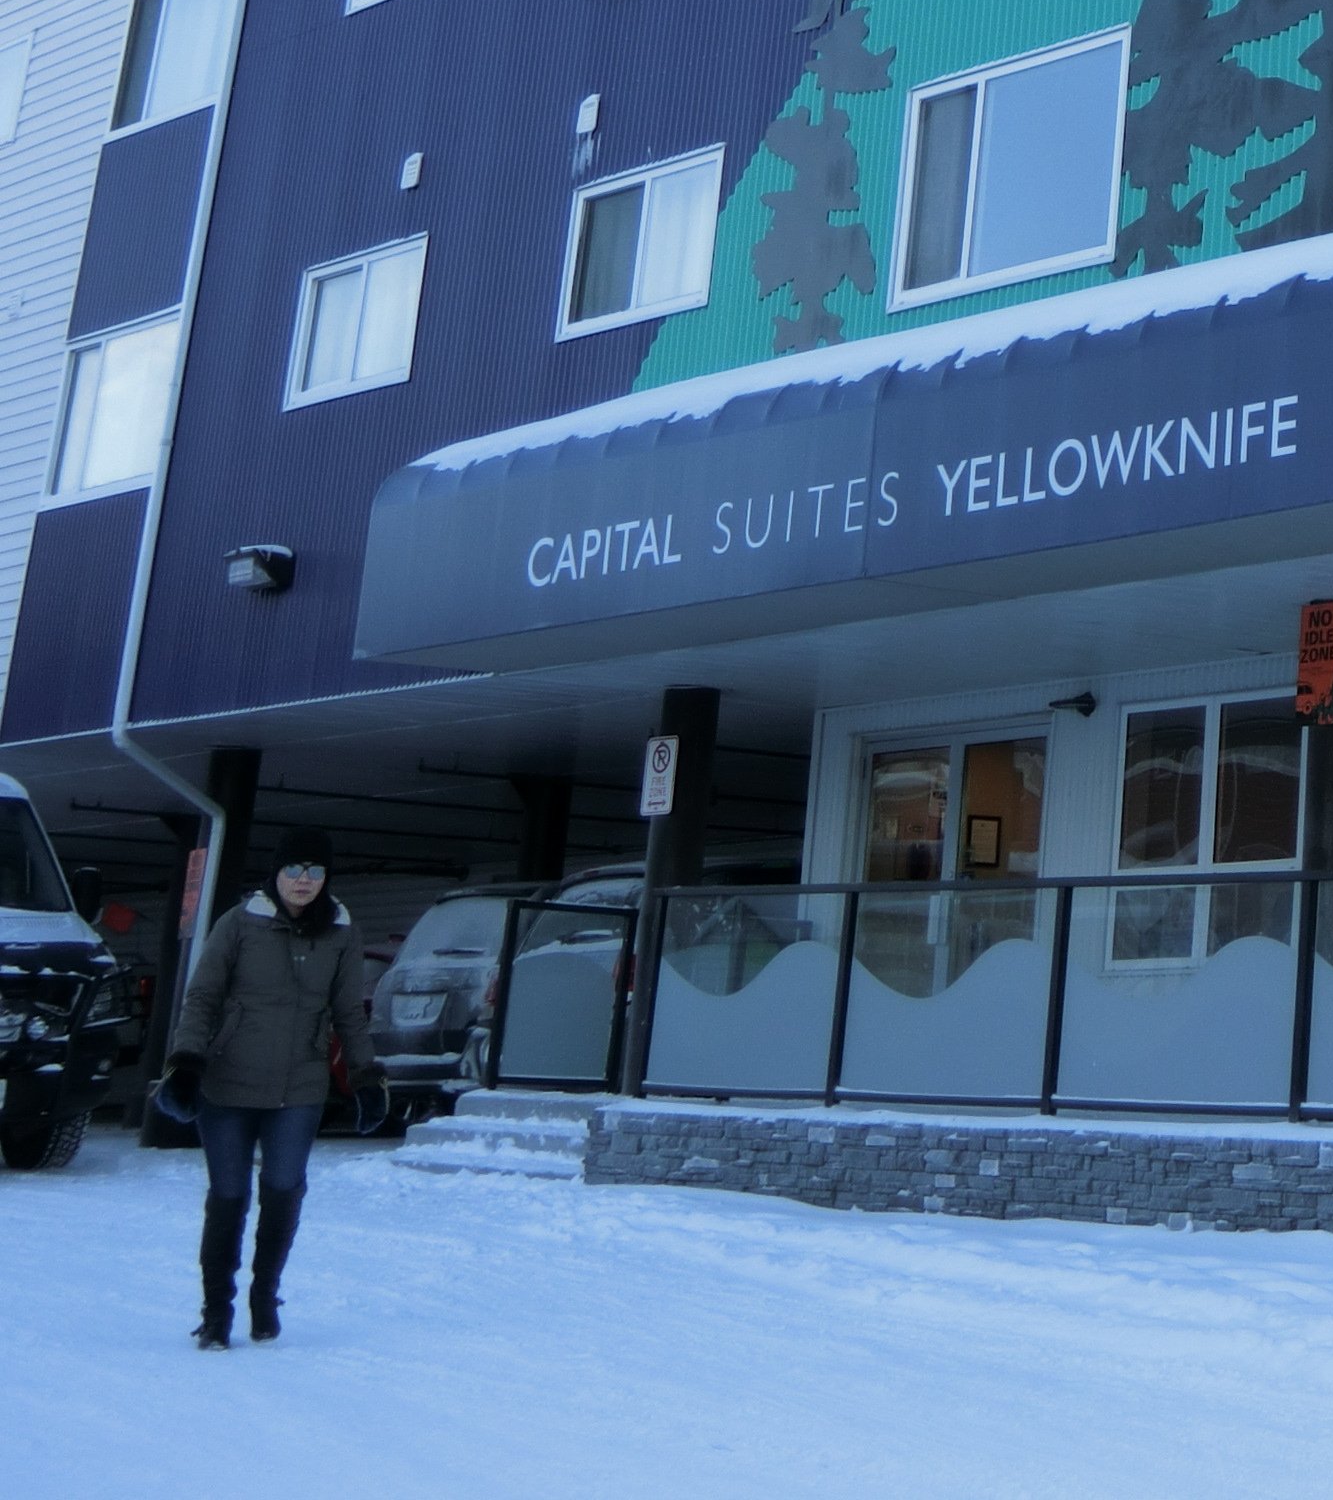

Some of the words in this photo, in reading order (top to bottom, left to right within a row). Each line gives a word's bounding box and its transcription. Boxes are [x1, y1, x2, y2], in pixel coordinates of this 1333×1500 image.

[527, 514, 682, 588] CAPITAL
[712, 471, 900, 555] SUITES
[937, 394, 1300, 517] YELLOWKNIFE
[1309, 609, 1333, 629] NO
